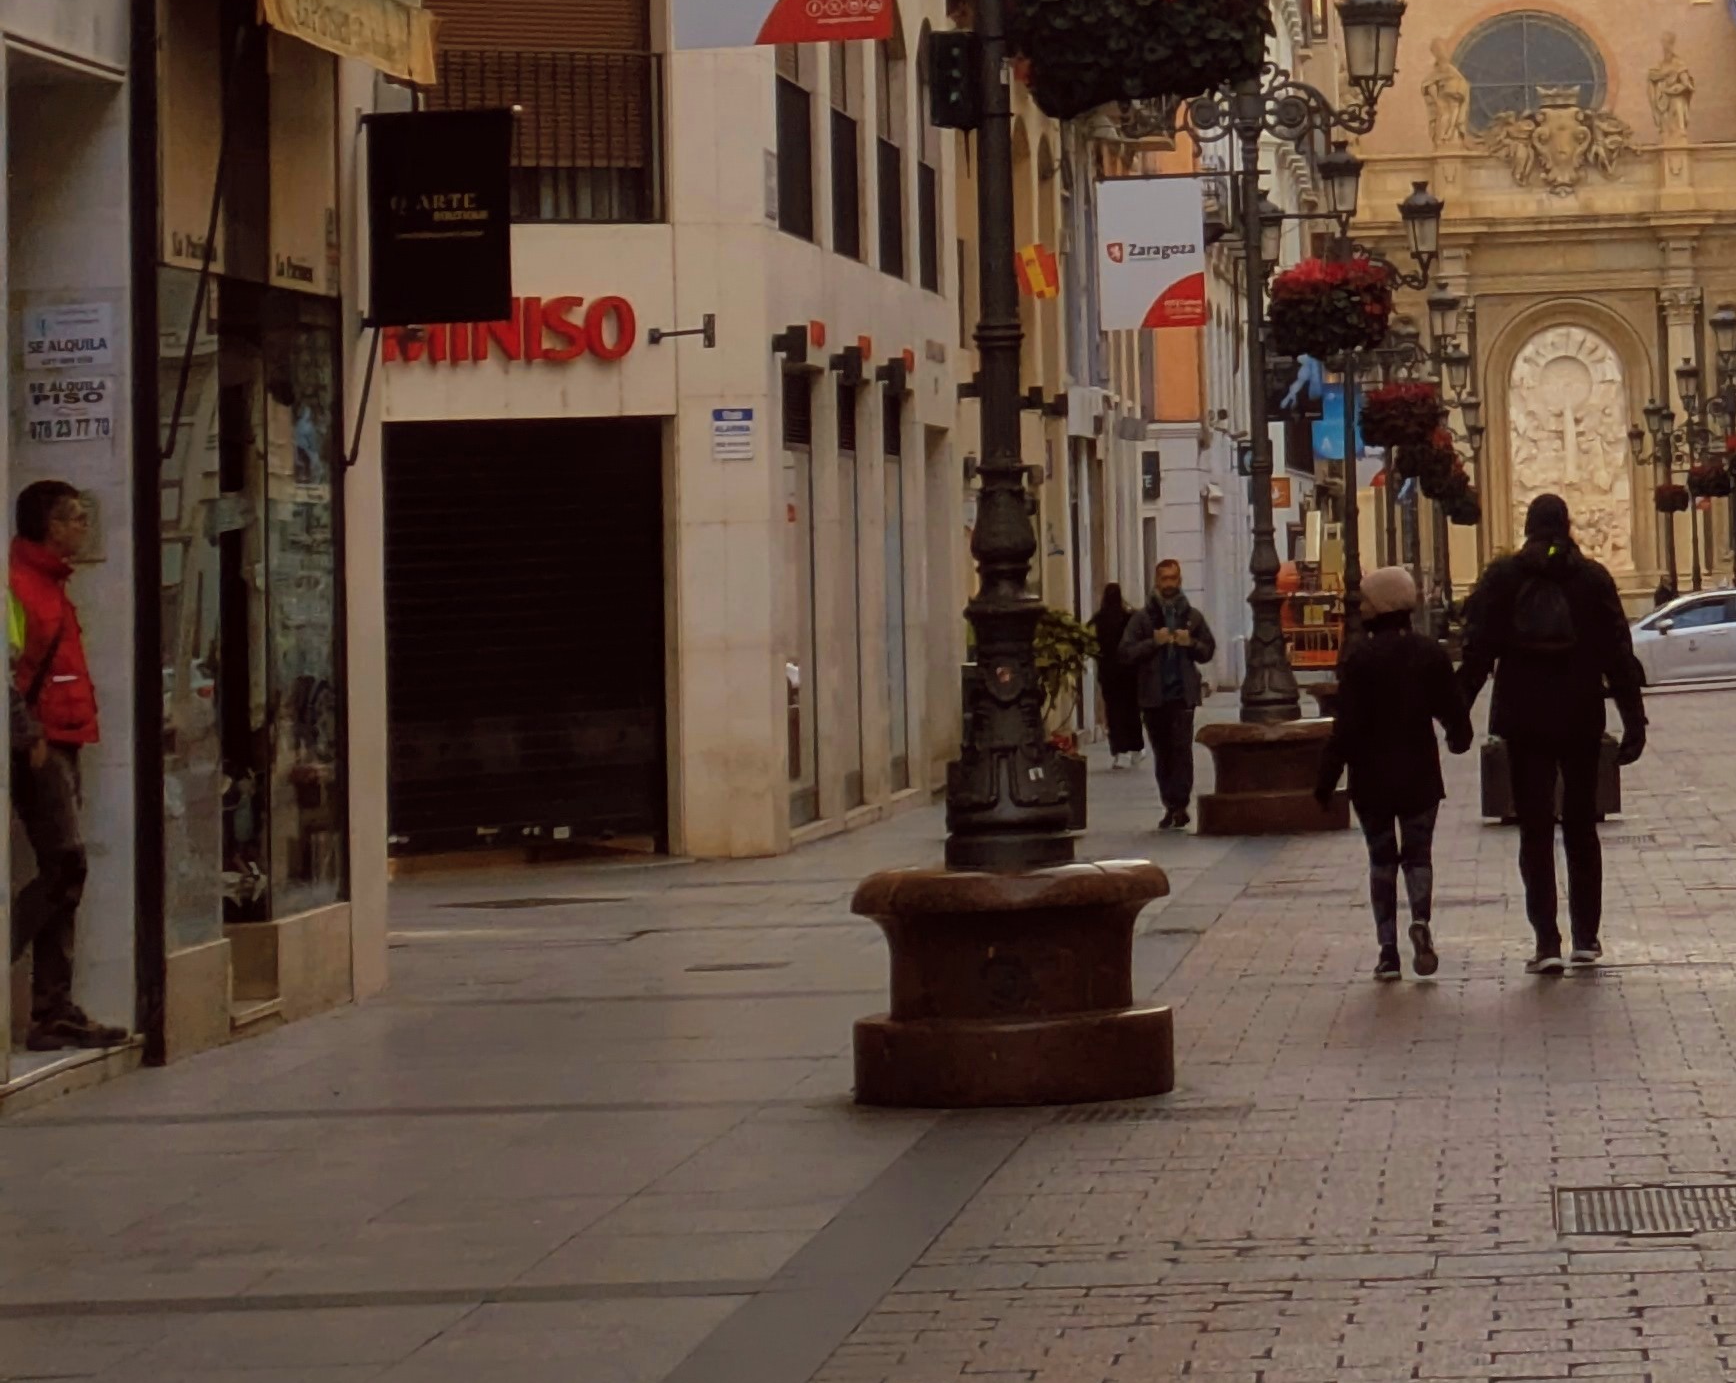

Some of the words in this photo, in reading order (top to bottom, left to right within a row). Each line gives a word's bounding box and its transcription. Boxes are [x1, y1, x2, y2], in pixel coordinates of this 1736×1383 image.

[1129, 244, 1195, 259] Zaragoza
[48, 337, 108, 353] ALQUILA
[33, 392, 104, 405] PISO
